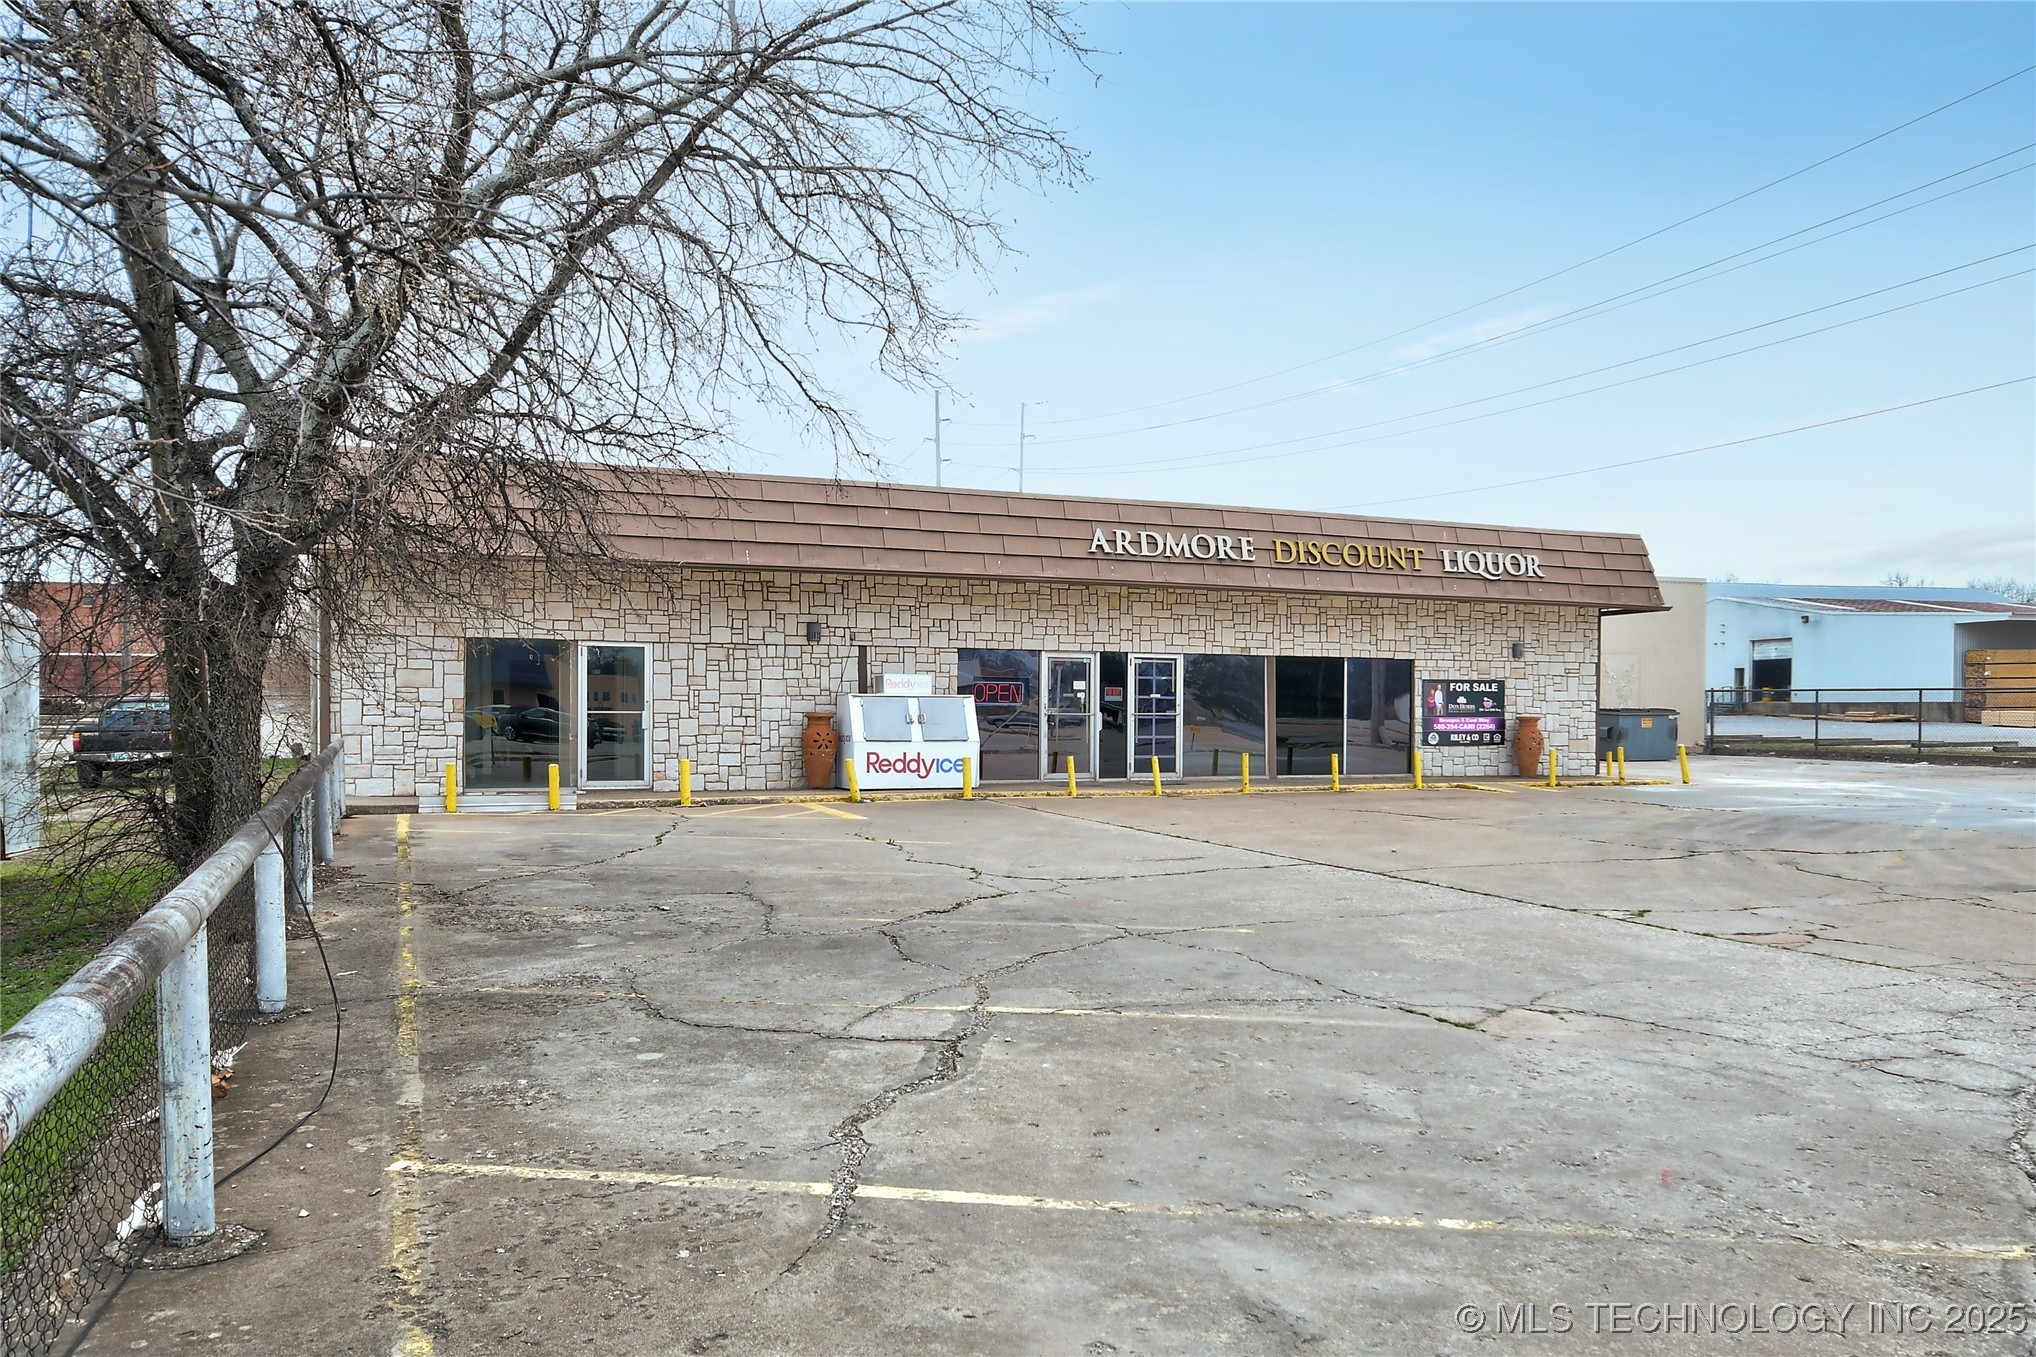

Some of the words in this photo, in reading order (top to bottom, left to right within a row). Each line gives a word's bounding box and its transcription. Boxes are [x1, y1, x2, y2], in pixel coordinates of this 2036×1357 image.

[1088, 528, 1256, 561] ARDMORE
[1273, 538, 1425, 571] DISCOUNT
[1440, 549, 1546, 580] LIQUOR
[973, 683, 1023, 703] OPEN
[1450, 683, 1470, 692] FOR
[1472, 683, 1498, 692] SALE
